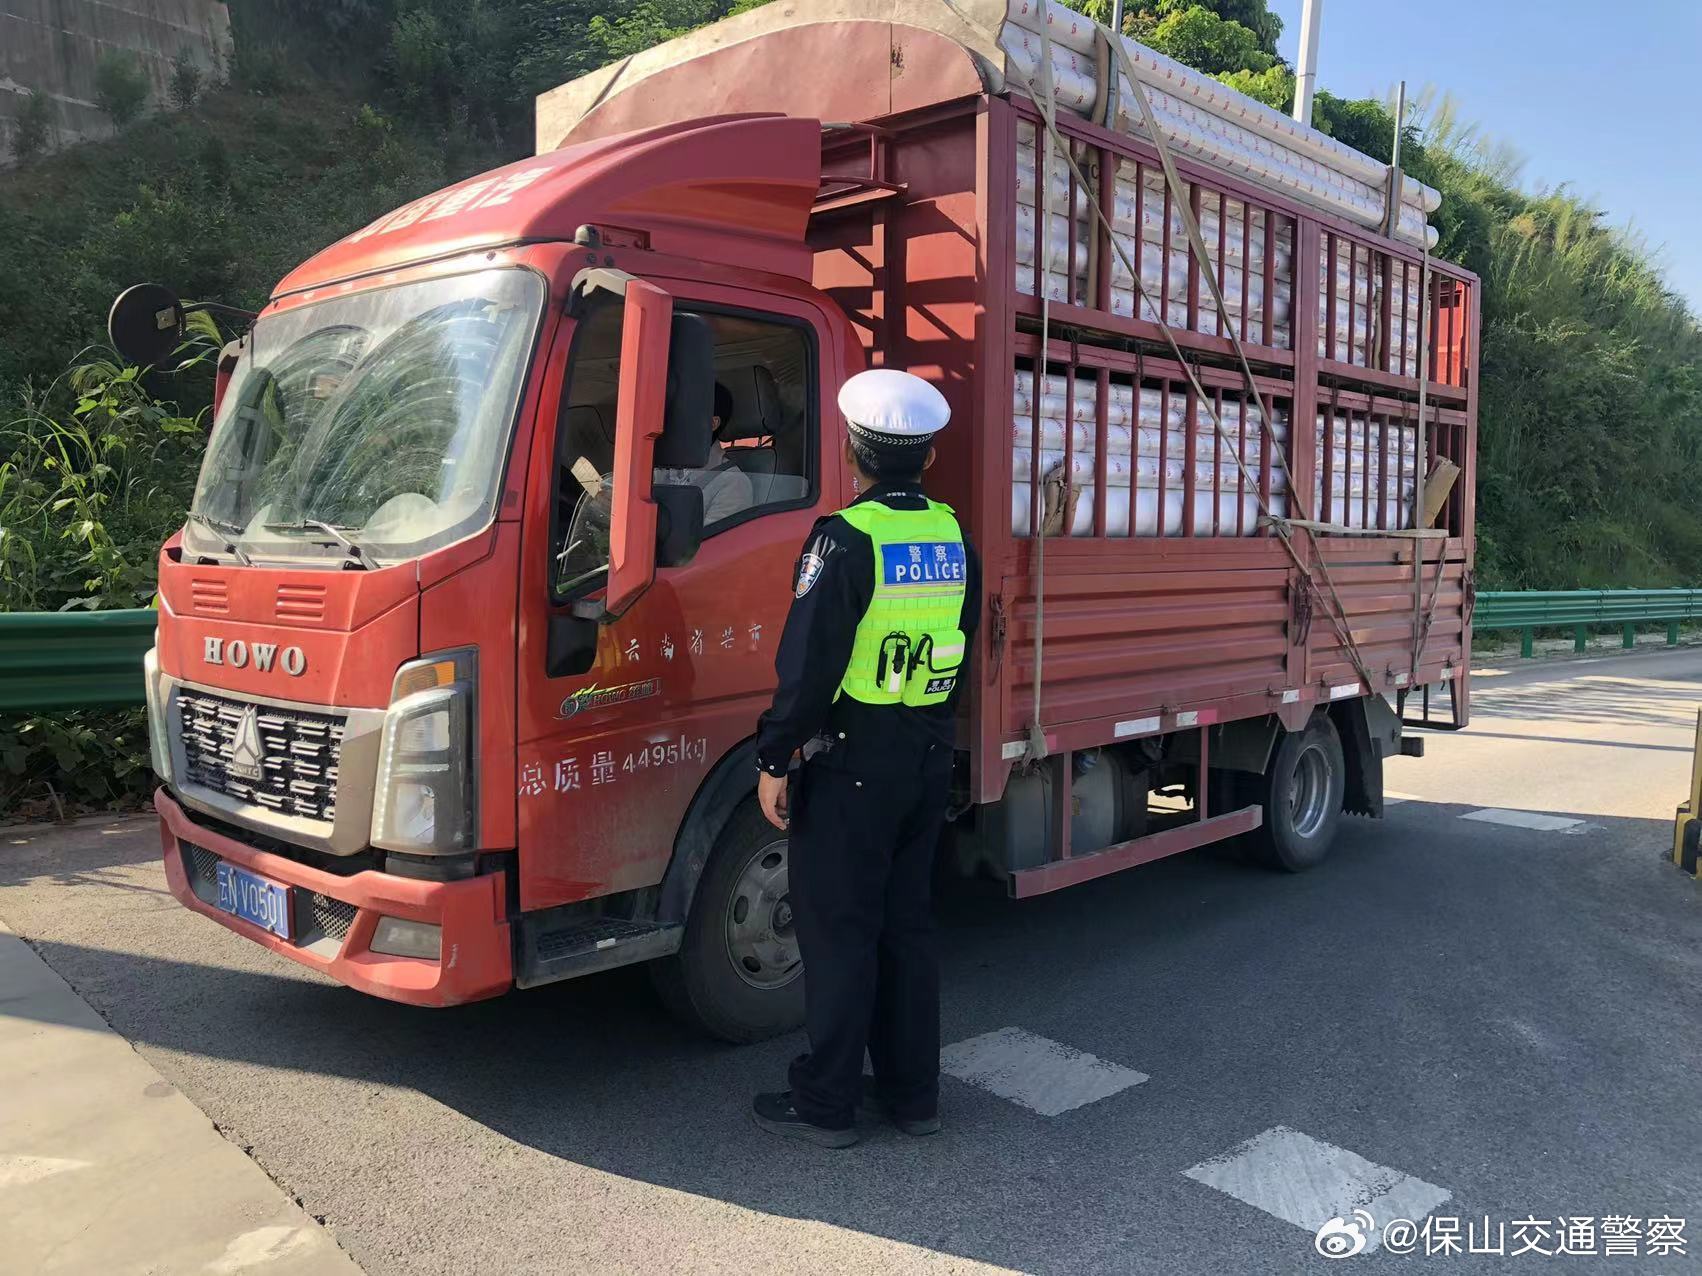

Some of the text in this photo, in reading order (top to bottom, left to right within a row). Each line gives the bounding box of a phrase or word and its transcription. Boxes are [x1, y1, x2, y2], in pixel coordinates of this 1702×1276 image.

[908, 545, 947, 562] 警察
[895, 563, 961, 582] POLICE
[203, 636, 306, 676] HOWO
